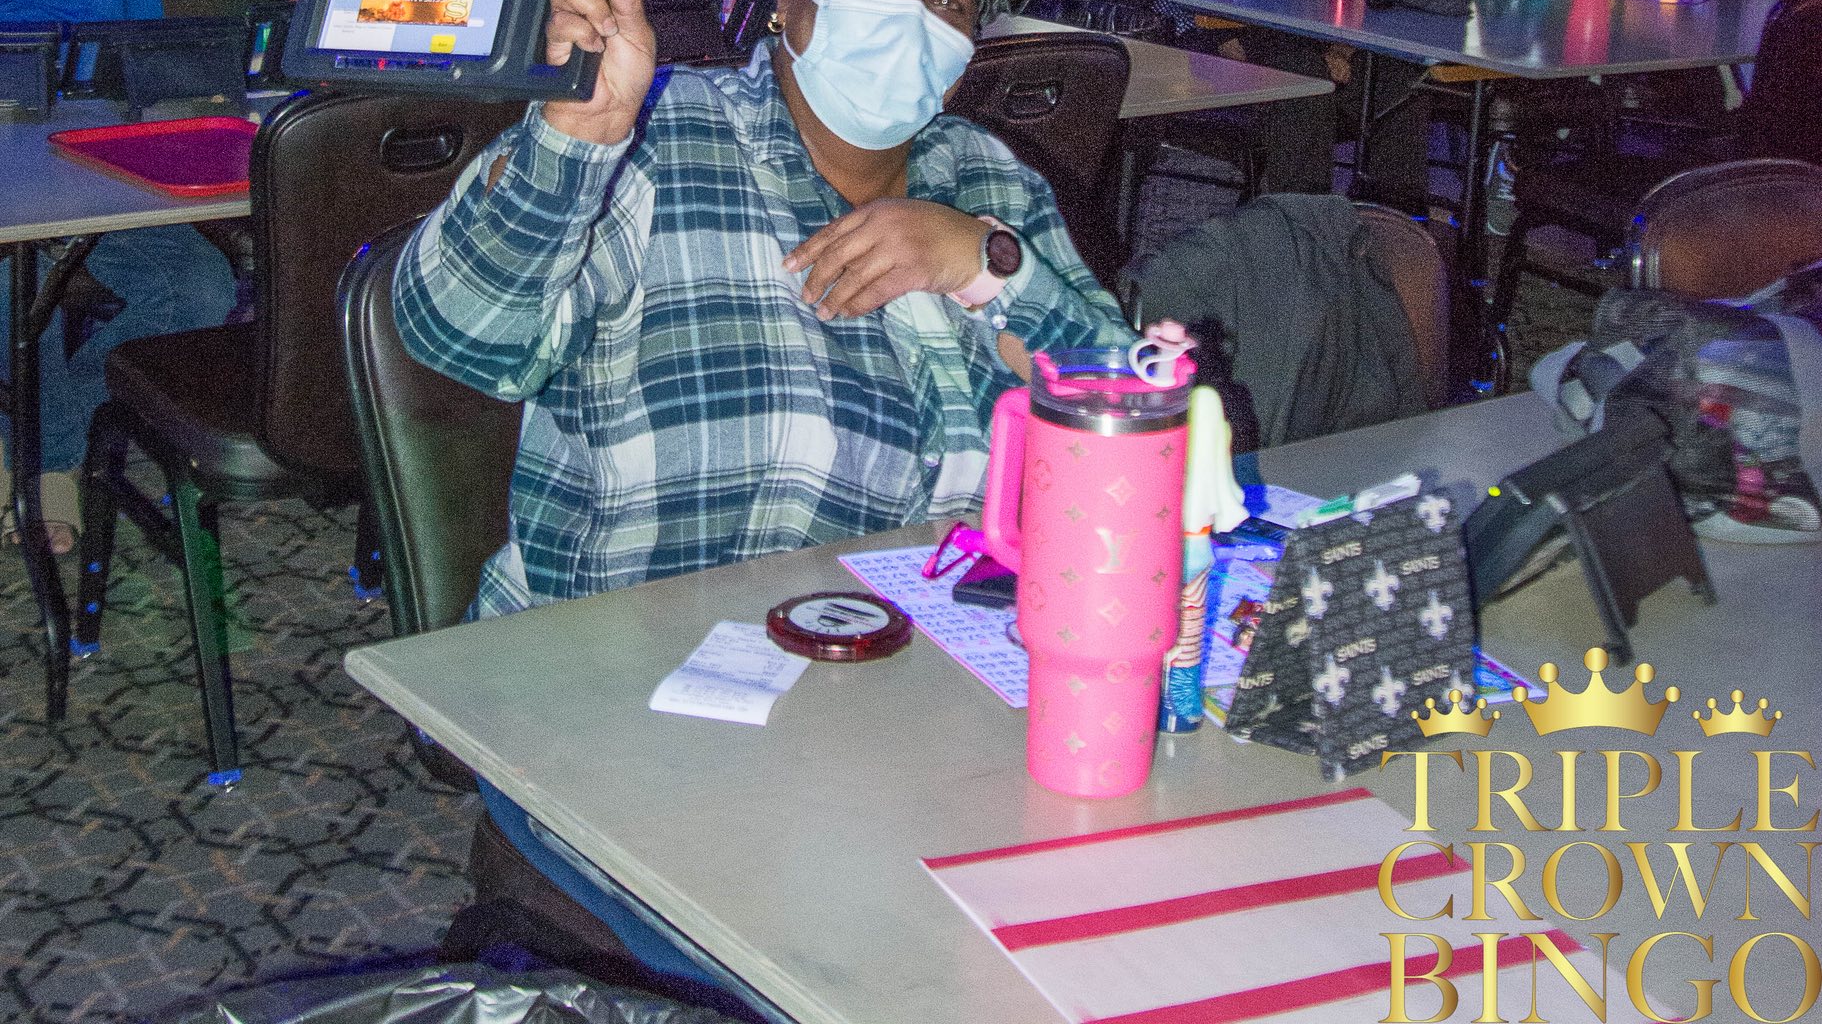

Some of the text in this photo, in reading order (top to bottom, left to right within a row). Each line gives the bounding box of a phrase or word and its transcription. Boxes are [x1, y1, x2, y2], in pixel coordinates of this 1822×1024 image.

[1322, 541, 1363, 565] SAINTS
[1402, 555, 1440, 576] SAINTS
[1336, 638, 1377, 663] SAINTS
[1412, 664, 1451, 686] SAINTS
[1349, 734, 1389, 760] SAINTS
